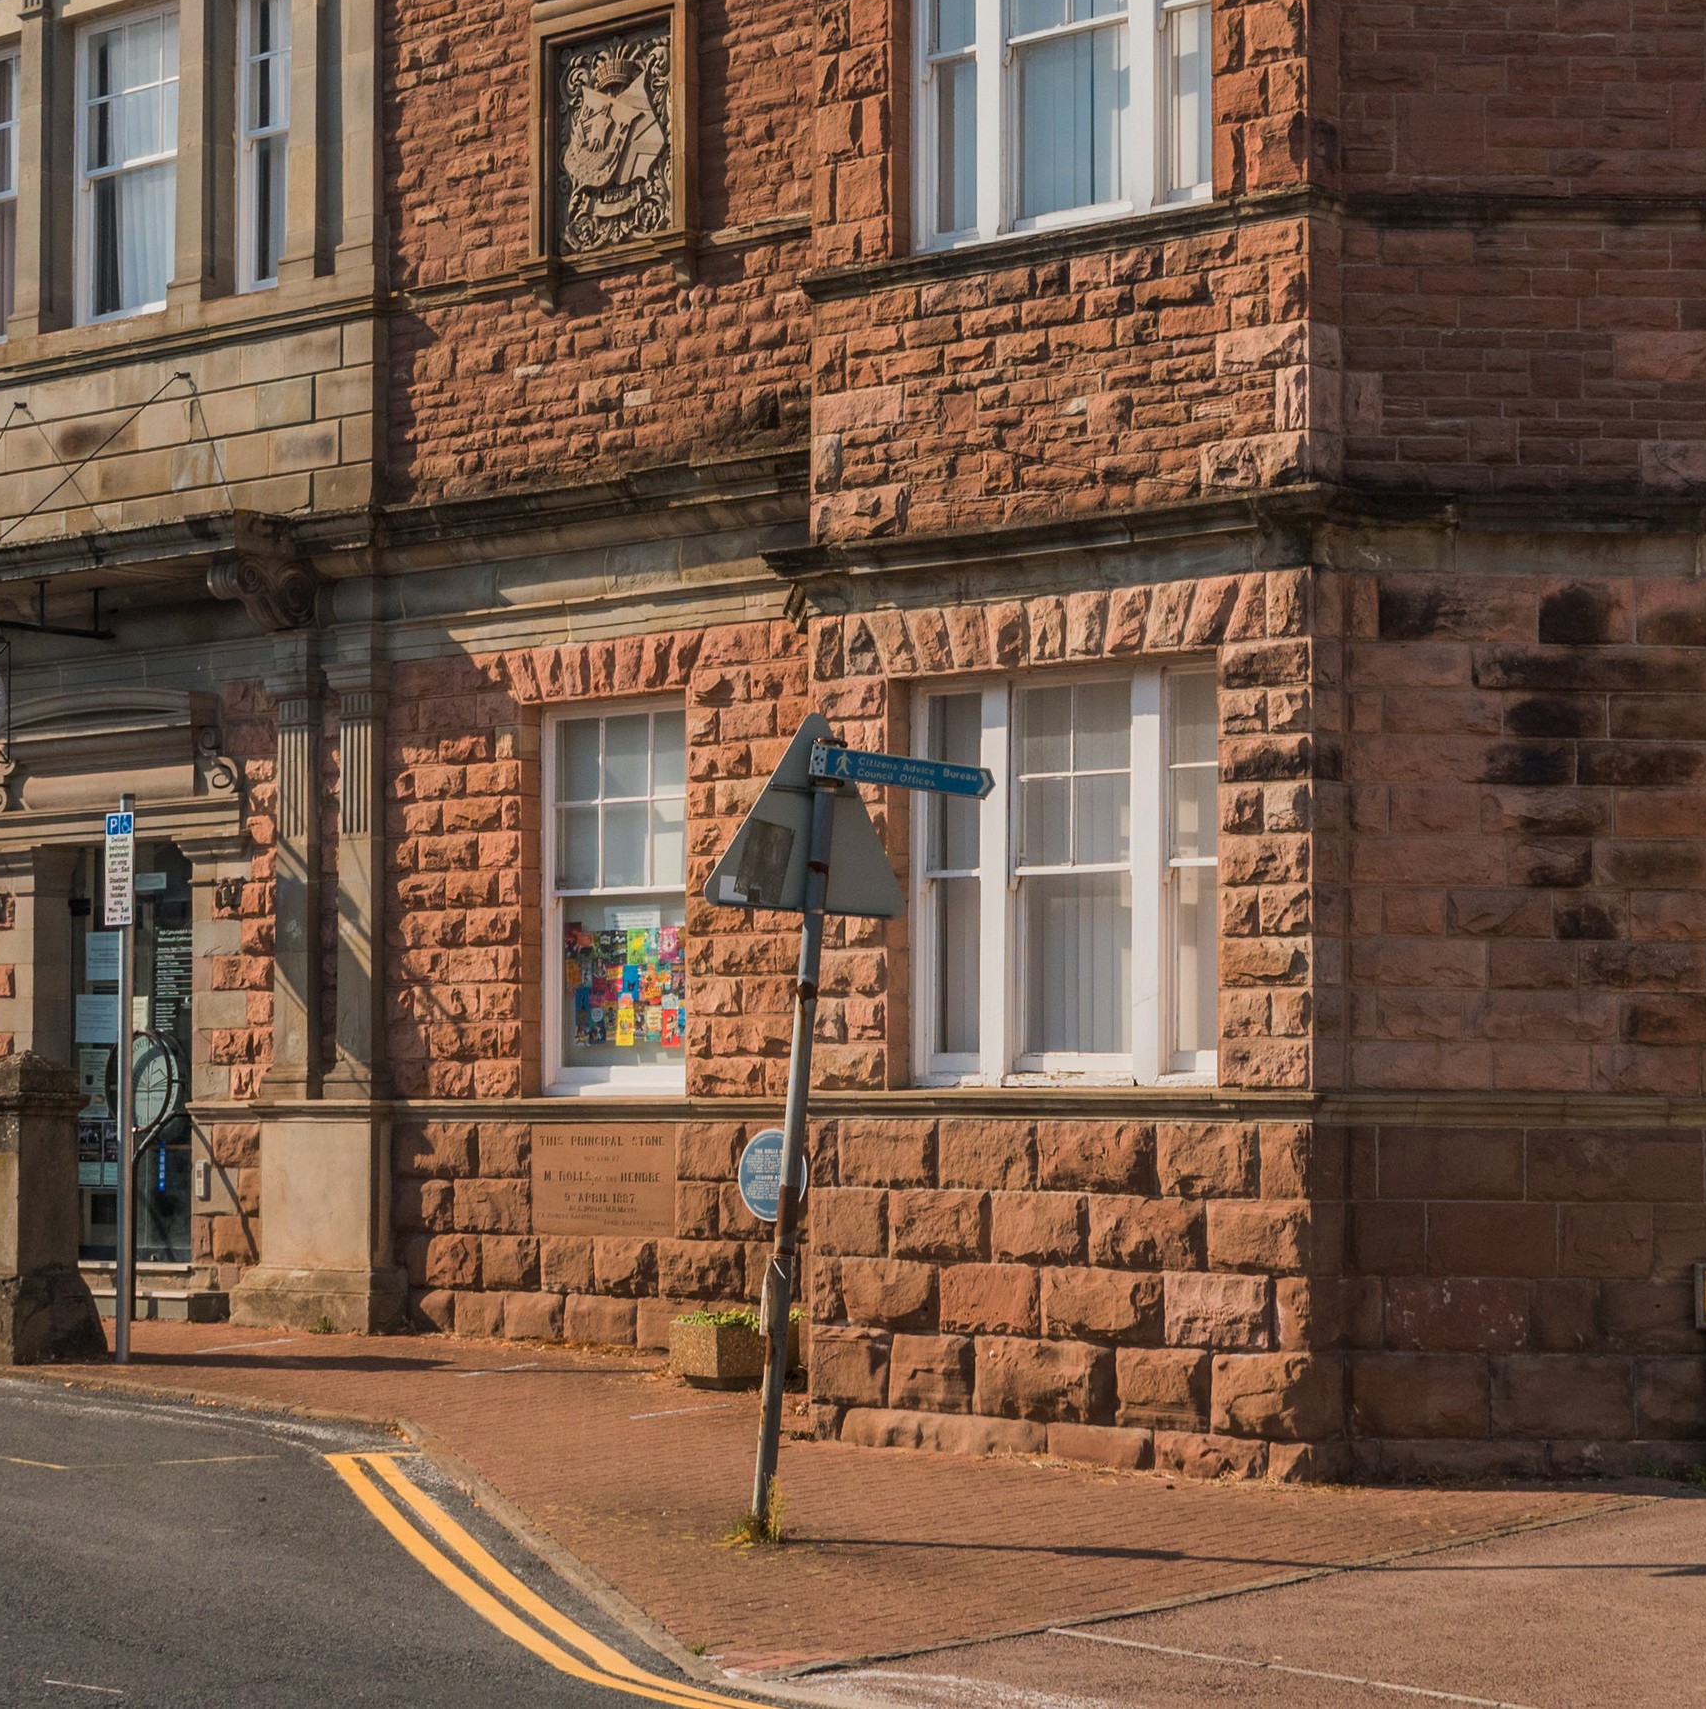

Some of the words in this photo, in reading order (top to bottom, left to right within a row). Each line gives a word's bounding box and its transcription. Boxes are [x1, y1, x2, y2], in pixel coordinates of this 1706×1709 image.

[858, 756, 898, 771] Citizens
[902, 763, 936, 776] Advice
[943, 768, 978, 782] Bureau
[857, 769, 894, 781] Council
[899, 774, 936, 787] Offices
[111, 818, 118, 833] P
[539, 1135, 564, 1146] THIS
[570, 1135, 624, 1147] PRINCIPAL
[632, 1136, 665, 1147] STONE
[620, 1172, 661, 1183] HENDRE
[578, 1193, 609, 1203] APRIL
[613, 1193, 636, 1204] 1887
